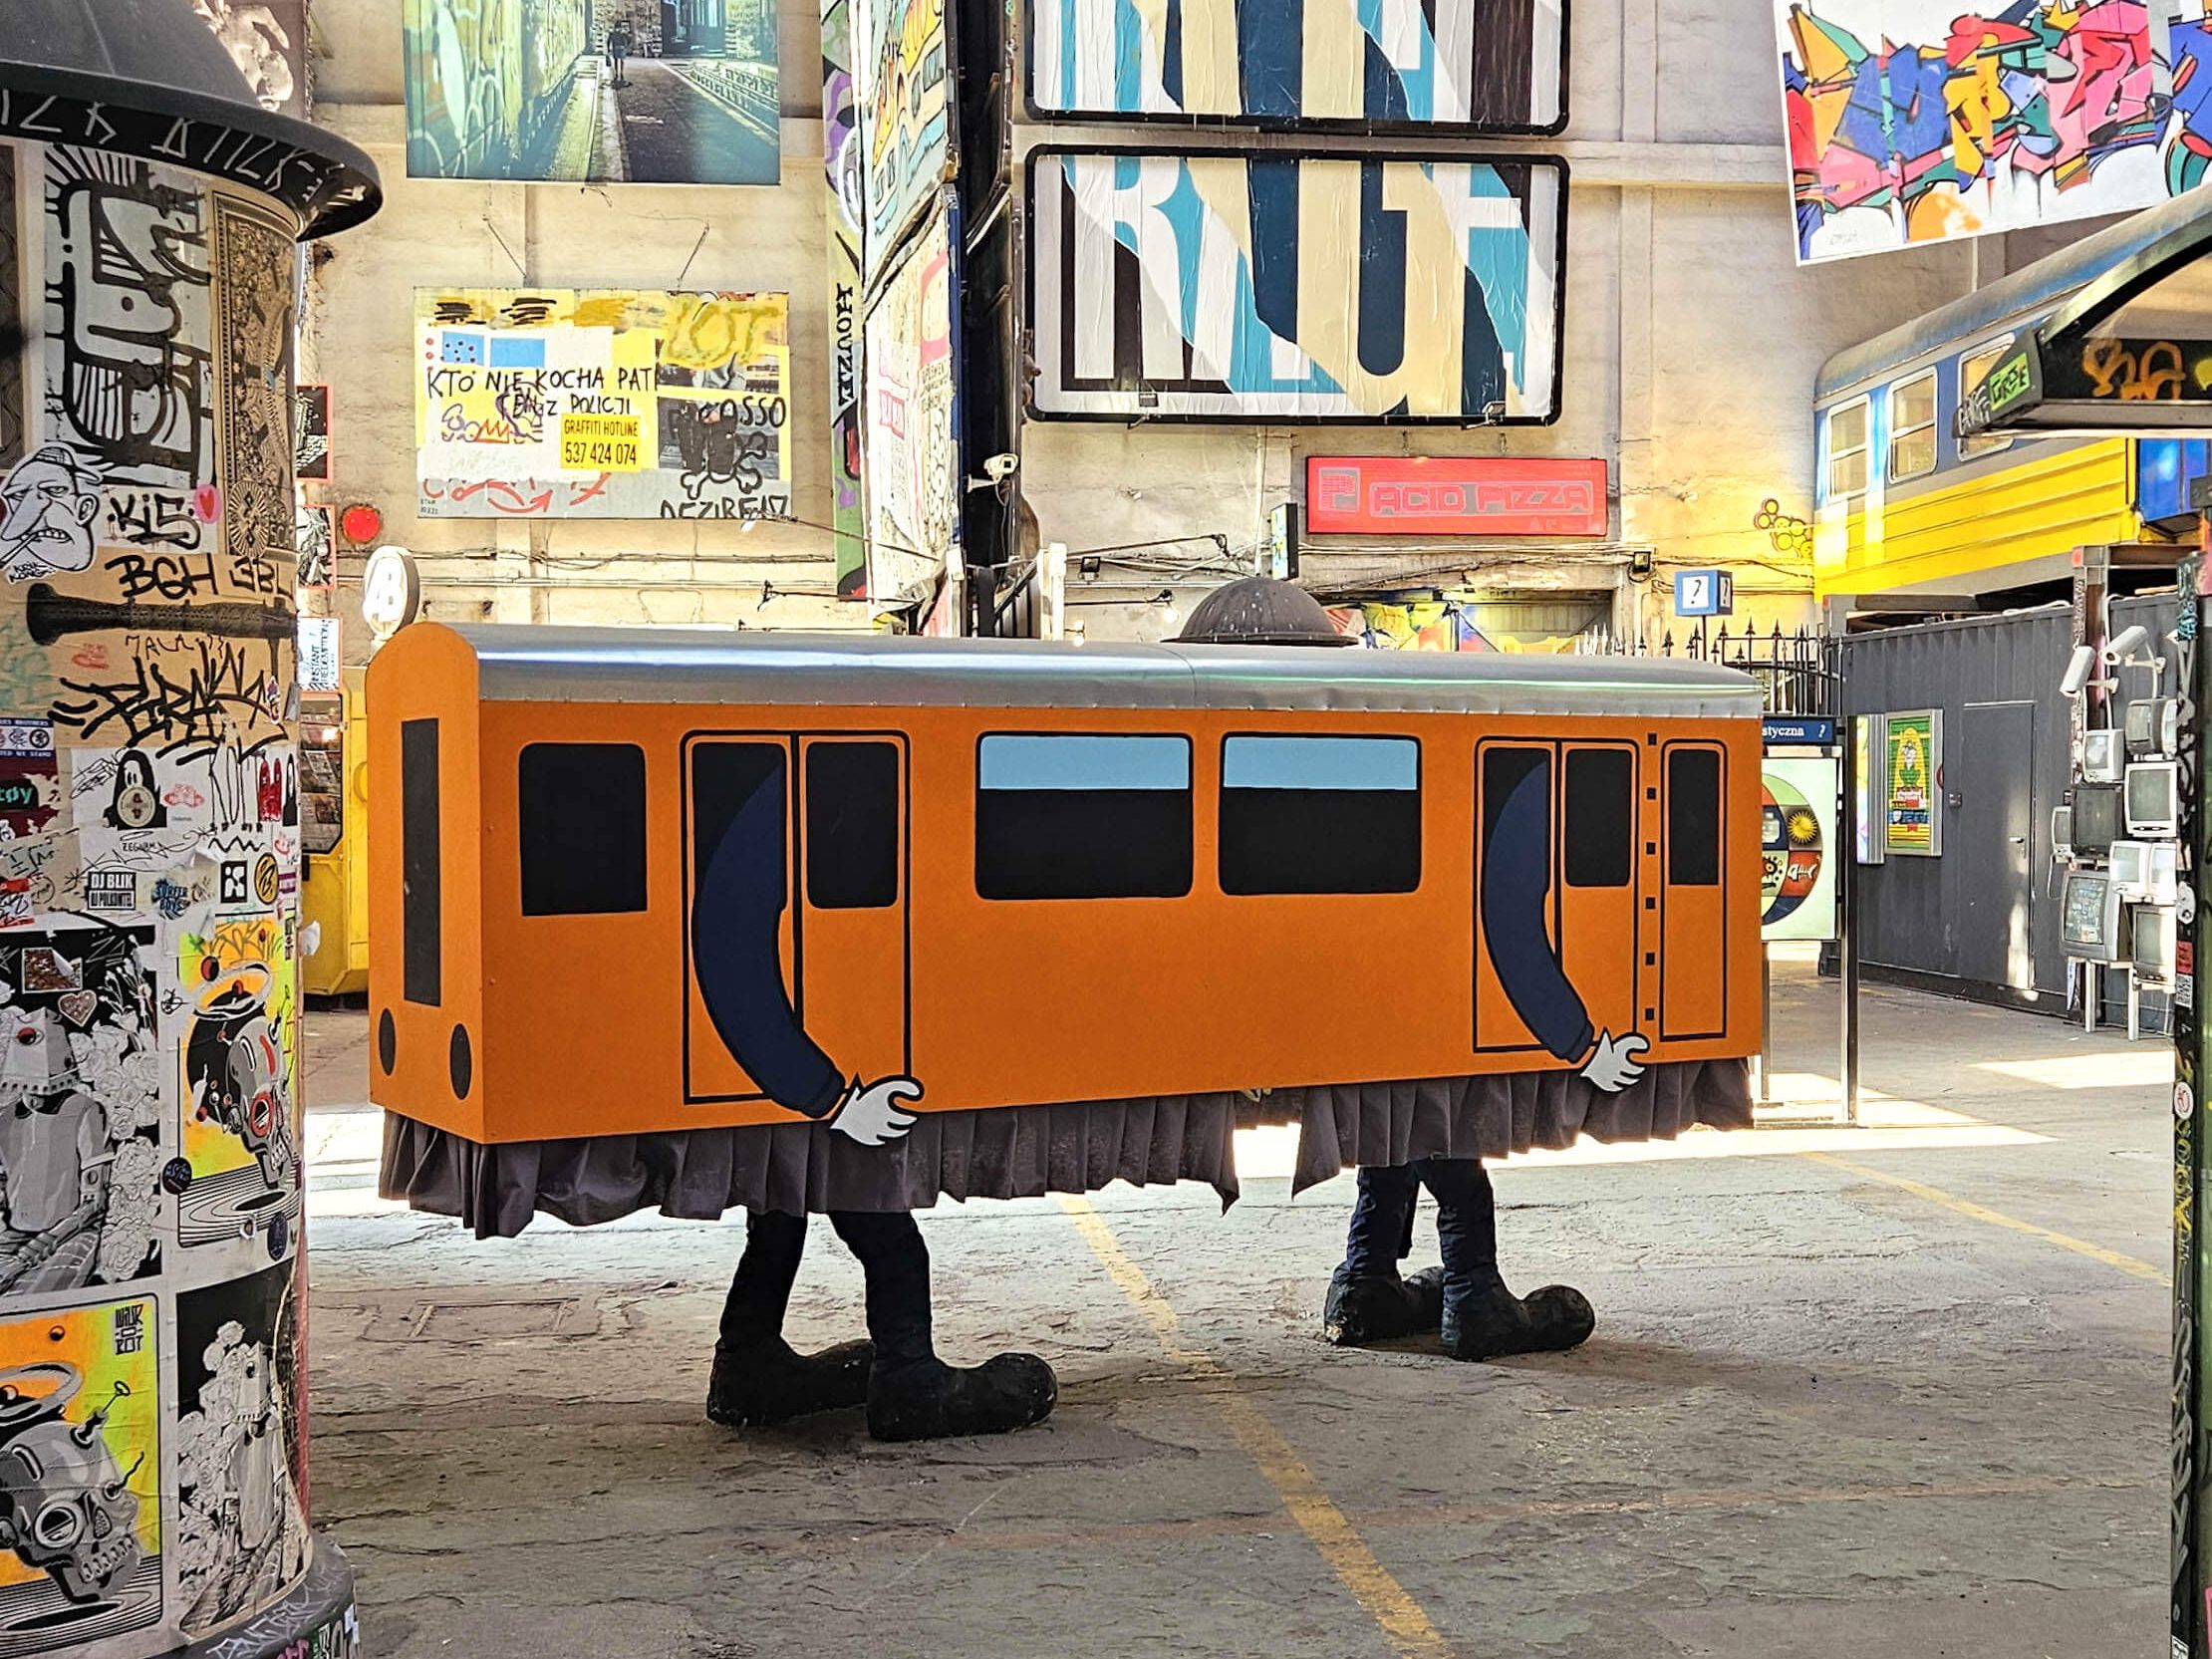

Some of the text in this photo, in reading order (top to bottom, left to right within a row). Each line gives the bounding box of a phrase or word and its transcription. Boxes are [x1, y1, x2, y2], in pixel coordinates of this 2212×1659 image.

[427, 370, 474, 398] KTO
[486, 371, 525, 393] NIE
[536, 369, 605, 391] KOCHA
[564, 418, 639, 437] GRAFFITI HOTLINE
[565, 443, 637, 464] 537 424 074
[1373, 484, 1466, 512] ACID
[1476, 483, 1591, 512] PIZZA
[91, 873, 134, 889] DJ BLIK
